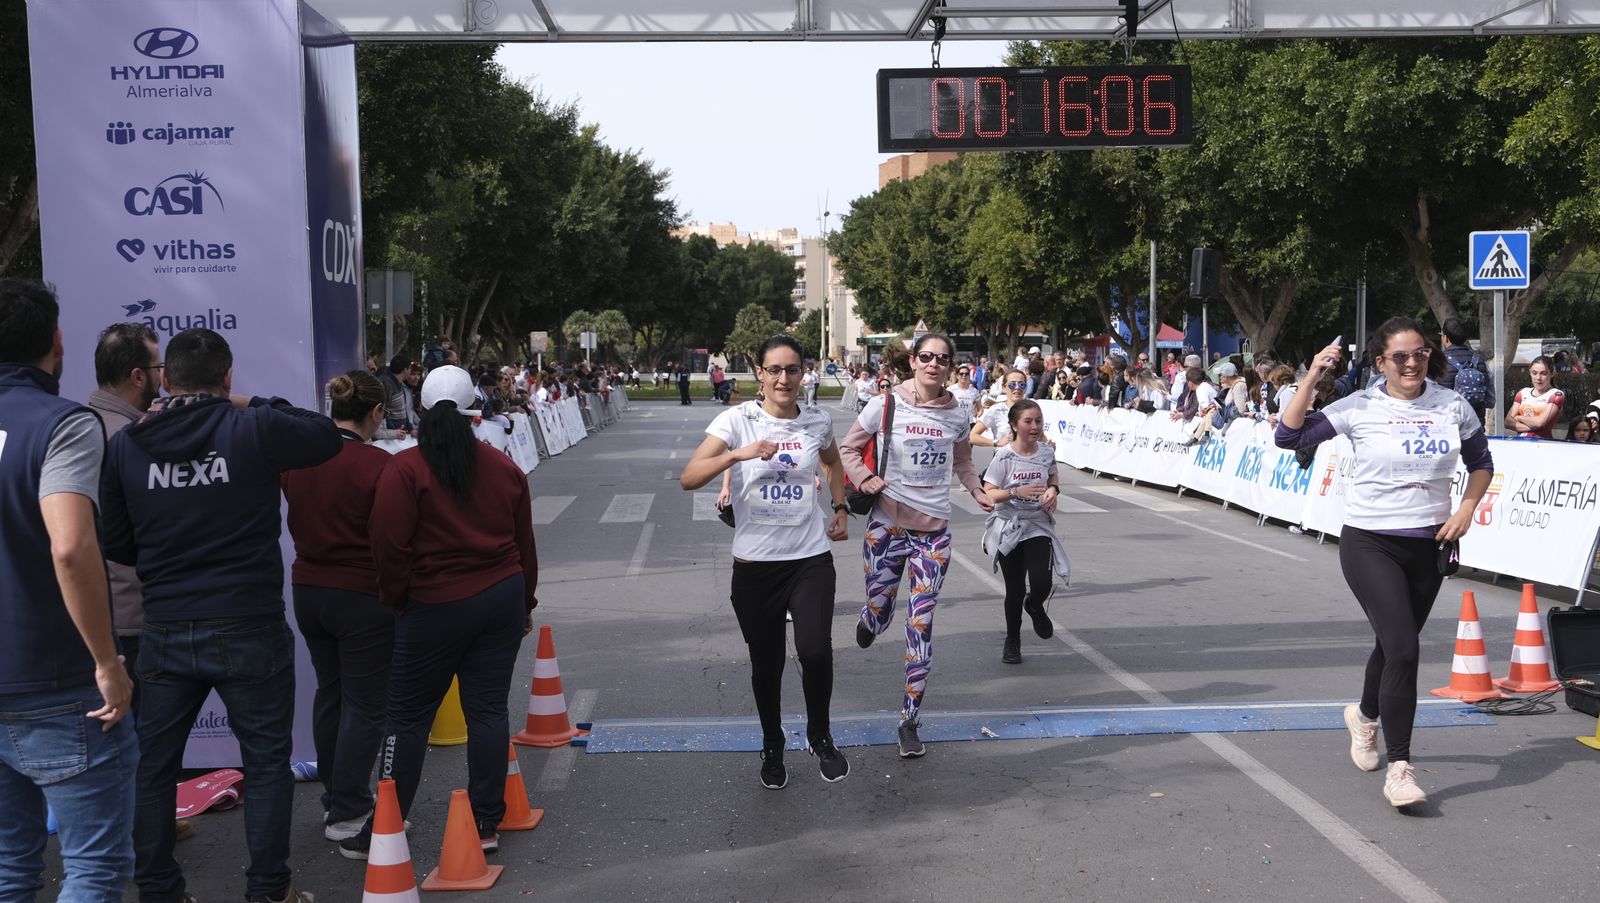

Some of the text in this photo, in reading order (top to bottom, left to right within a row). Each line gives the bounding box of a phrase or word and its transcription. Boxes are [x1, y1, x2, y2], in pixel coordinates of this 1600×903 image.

[111, 64, 225, 80] HYUNDAI
[126, 84, 213, 98] Almerialva
[931, 75, 1176, 138] 00:16:06
[142, 122, 235, 146] cajamar
[124, 186, 203, 216] CASI
[153, 239, 236, 260] vithas
[154, 264, 237, 275] vivir para cuidarte
[142, 308, 237, 337] aqualia
[905, 425, 944, 438] MUJER
[1401, 439, 1450, 455] 1240
[911, 452, 946, 465] 1275
[1013, 472, 1042, 481] MUJER
[759, 485, 803, 500] 1049
[1511, 475, 1598, 511] ALMERÍA
[1509, 508, 1551, 530] CIUDAD
